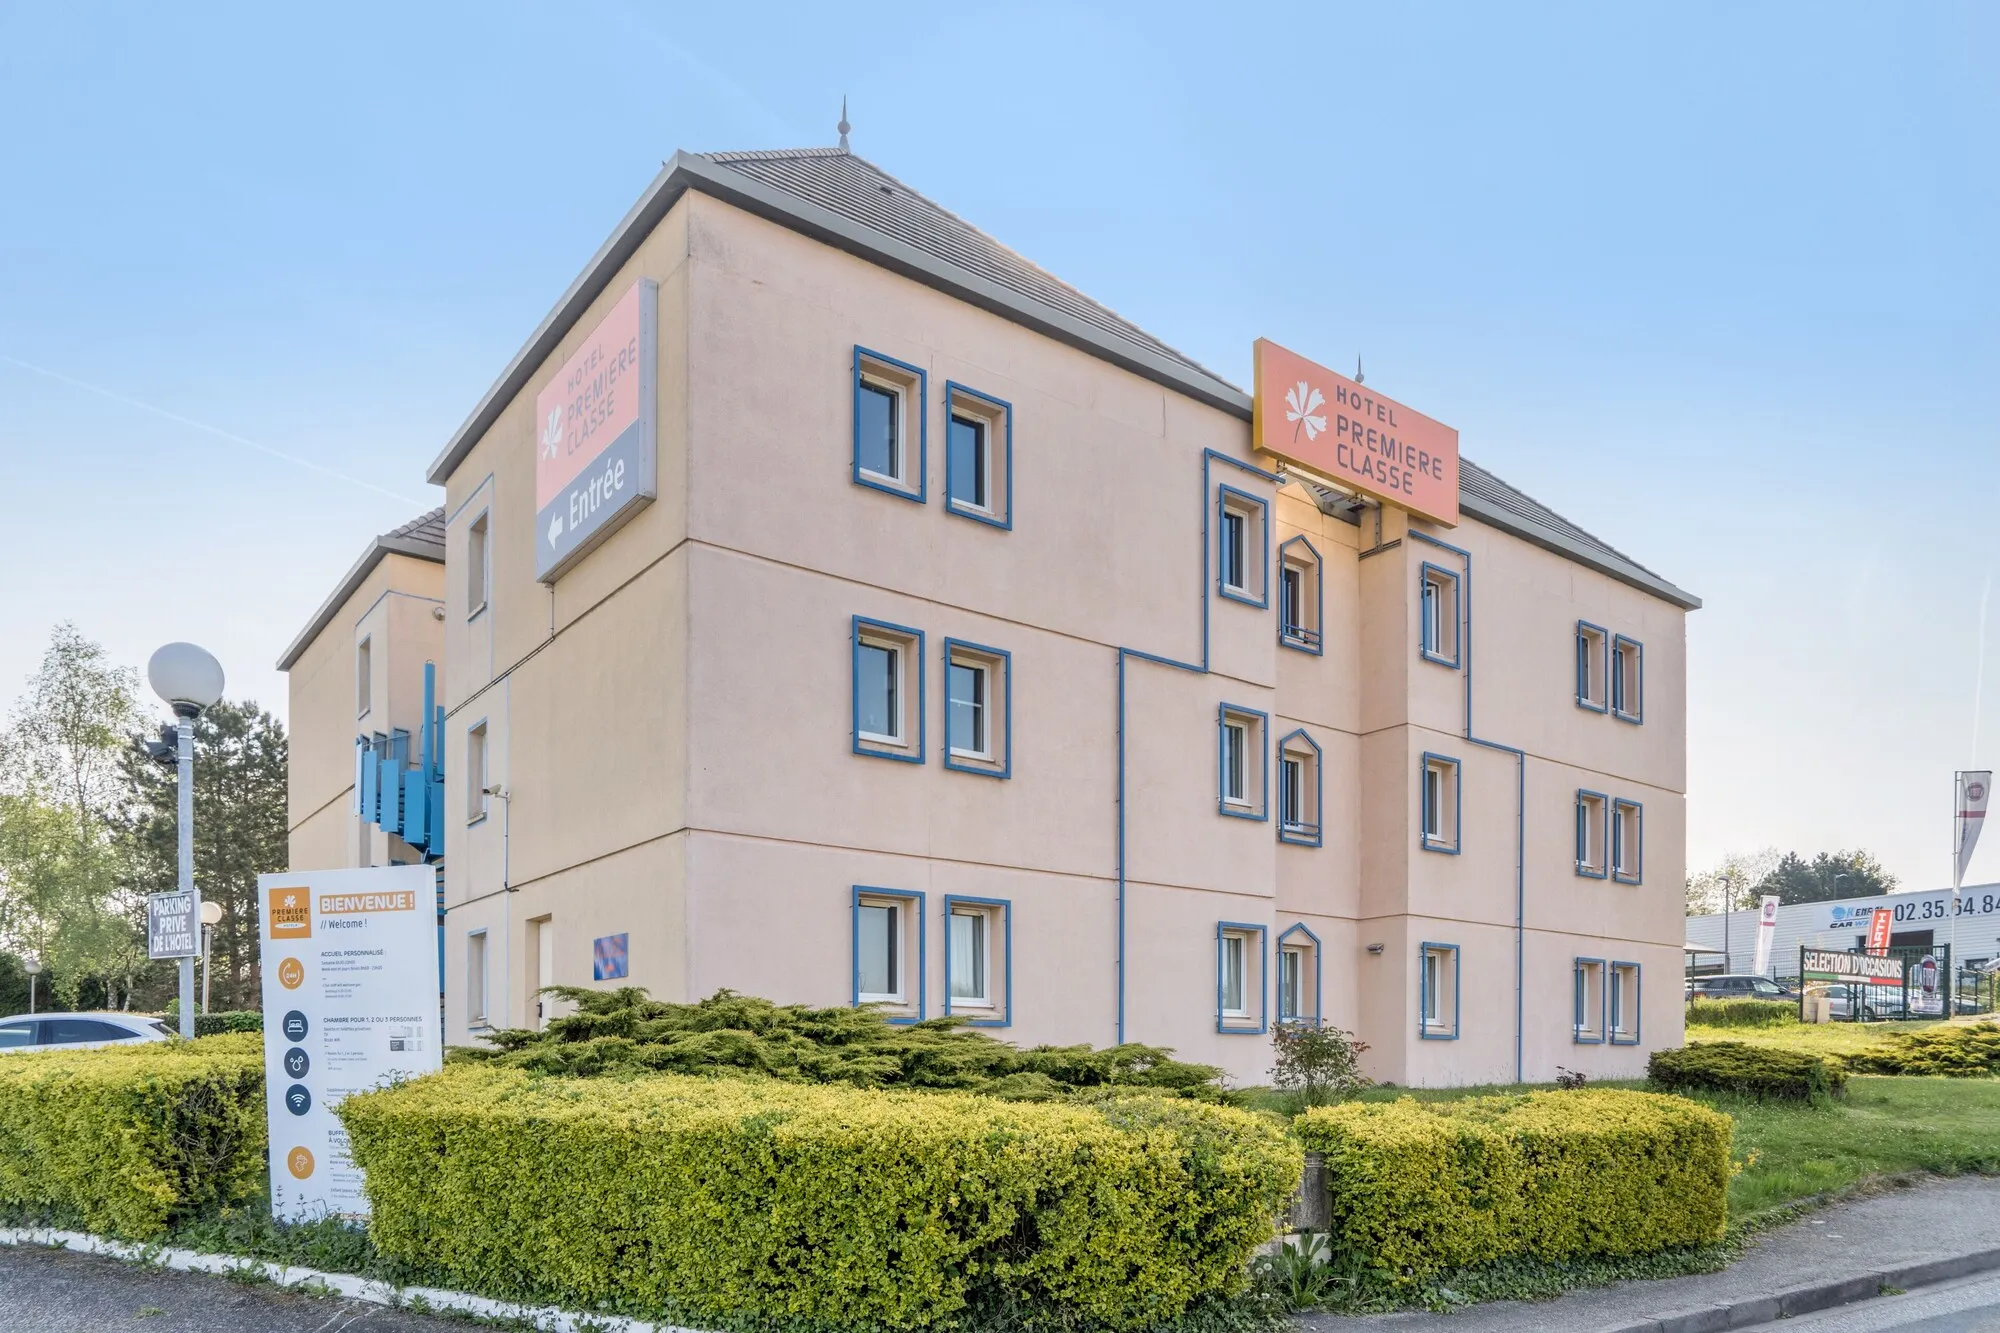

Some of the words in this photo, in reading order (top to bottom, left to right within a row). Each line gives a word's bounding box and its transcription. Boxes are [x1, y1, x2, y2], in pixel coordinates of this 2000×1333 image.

[567, 337, 637, 421] PREMIERE
[568, 342, 604, 395] HOTEL
[1336, 385, 1397, 428] HOTEL
[567, 390, 615, 456] CLASSE
[1337, 414, 1442, 481] PREMIERE
[1337, 443, 1413, 496] CLASSE
[569, 458, 625, 532] Entrée
[153, 896, 191, 916] PARKING
[321, 893, 406, 912] BIENVENUE
[409, 893, 413, 908] !
[159, 915, 187, 934] PRIVE
[277, 914, 304, 922] CLASSE
[328, 918, 363, 929] Welcome
[1829, 921, 1853, 929] CAR
[153, 935, 164, 953] DE
[343, 949, 384, 957] PERSONNALISÉ
[1803, 952, 1851, 974] SELECTION
